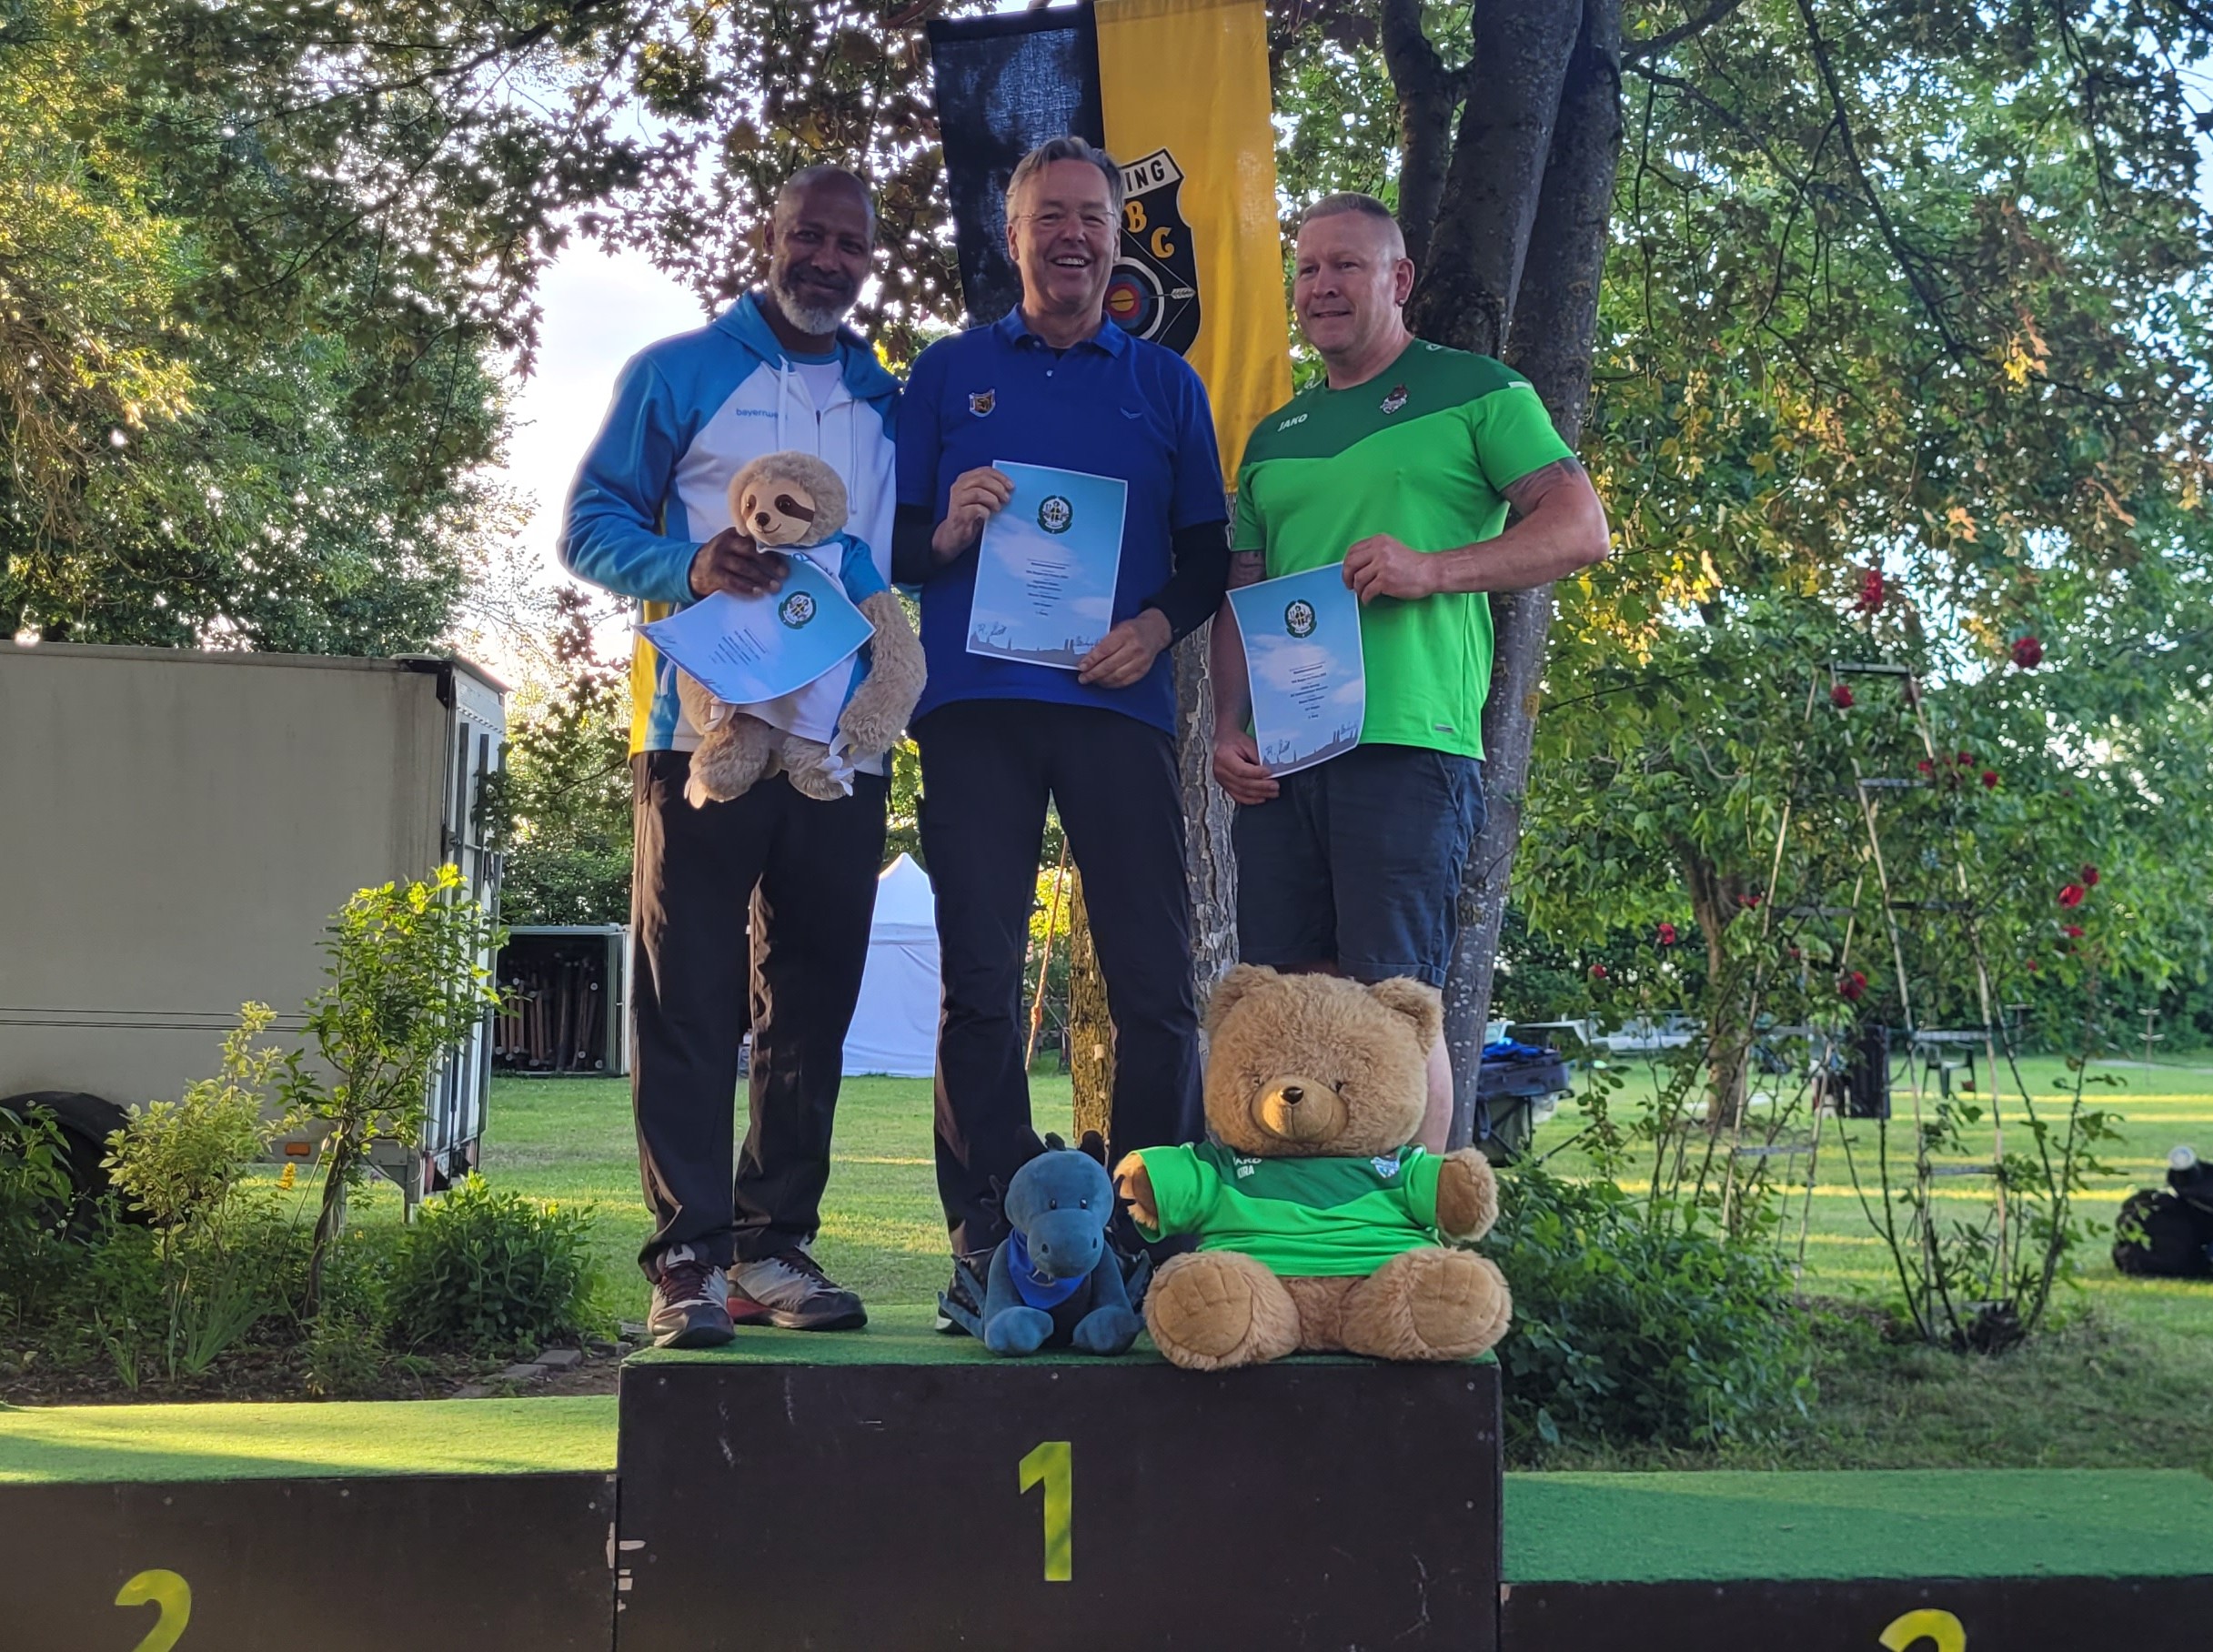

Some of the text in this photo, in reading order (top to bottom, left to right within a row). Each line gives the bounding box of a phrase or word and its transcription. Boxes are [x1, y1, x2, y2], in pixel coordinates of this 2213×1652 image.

[1124, 200, 1148, 233] B
[735, 408, 788, 419] bayernwe
[1277, 413, 1308, 432] JAKO
[1019, 1441, 1072, 1581] 1
[115, 1568, 192, 1652] 2
